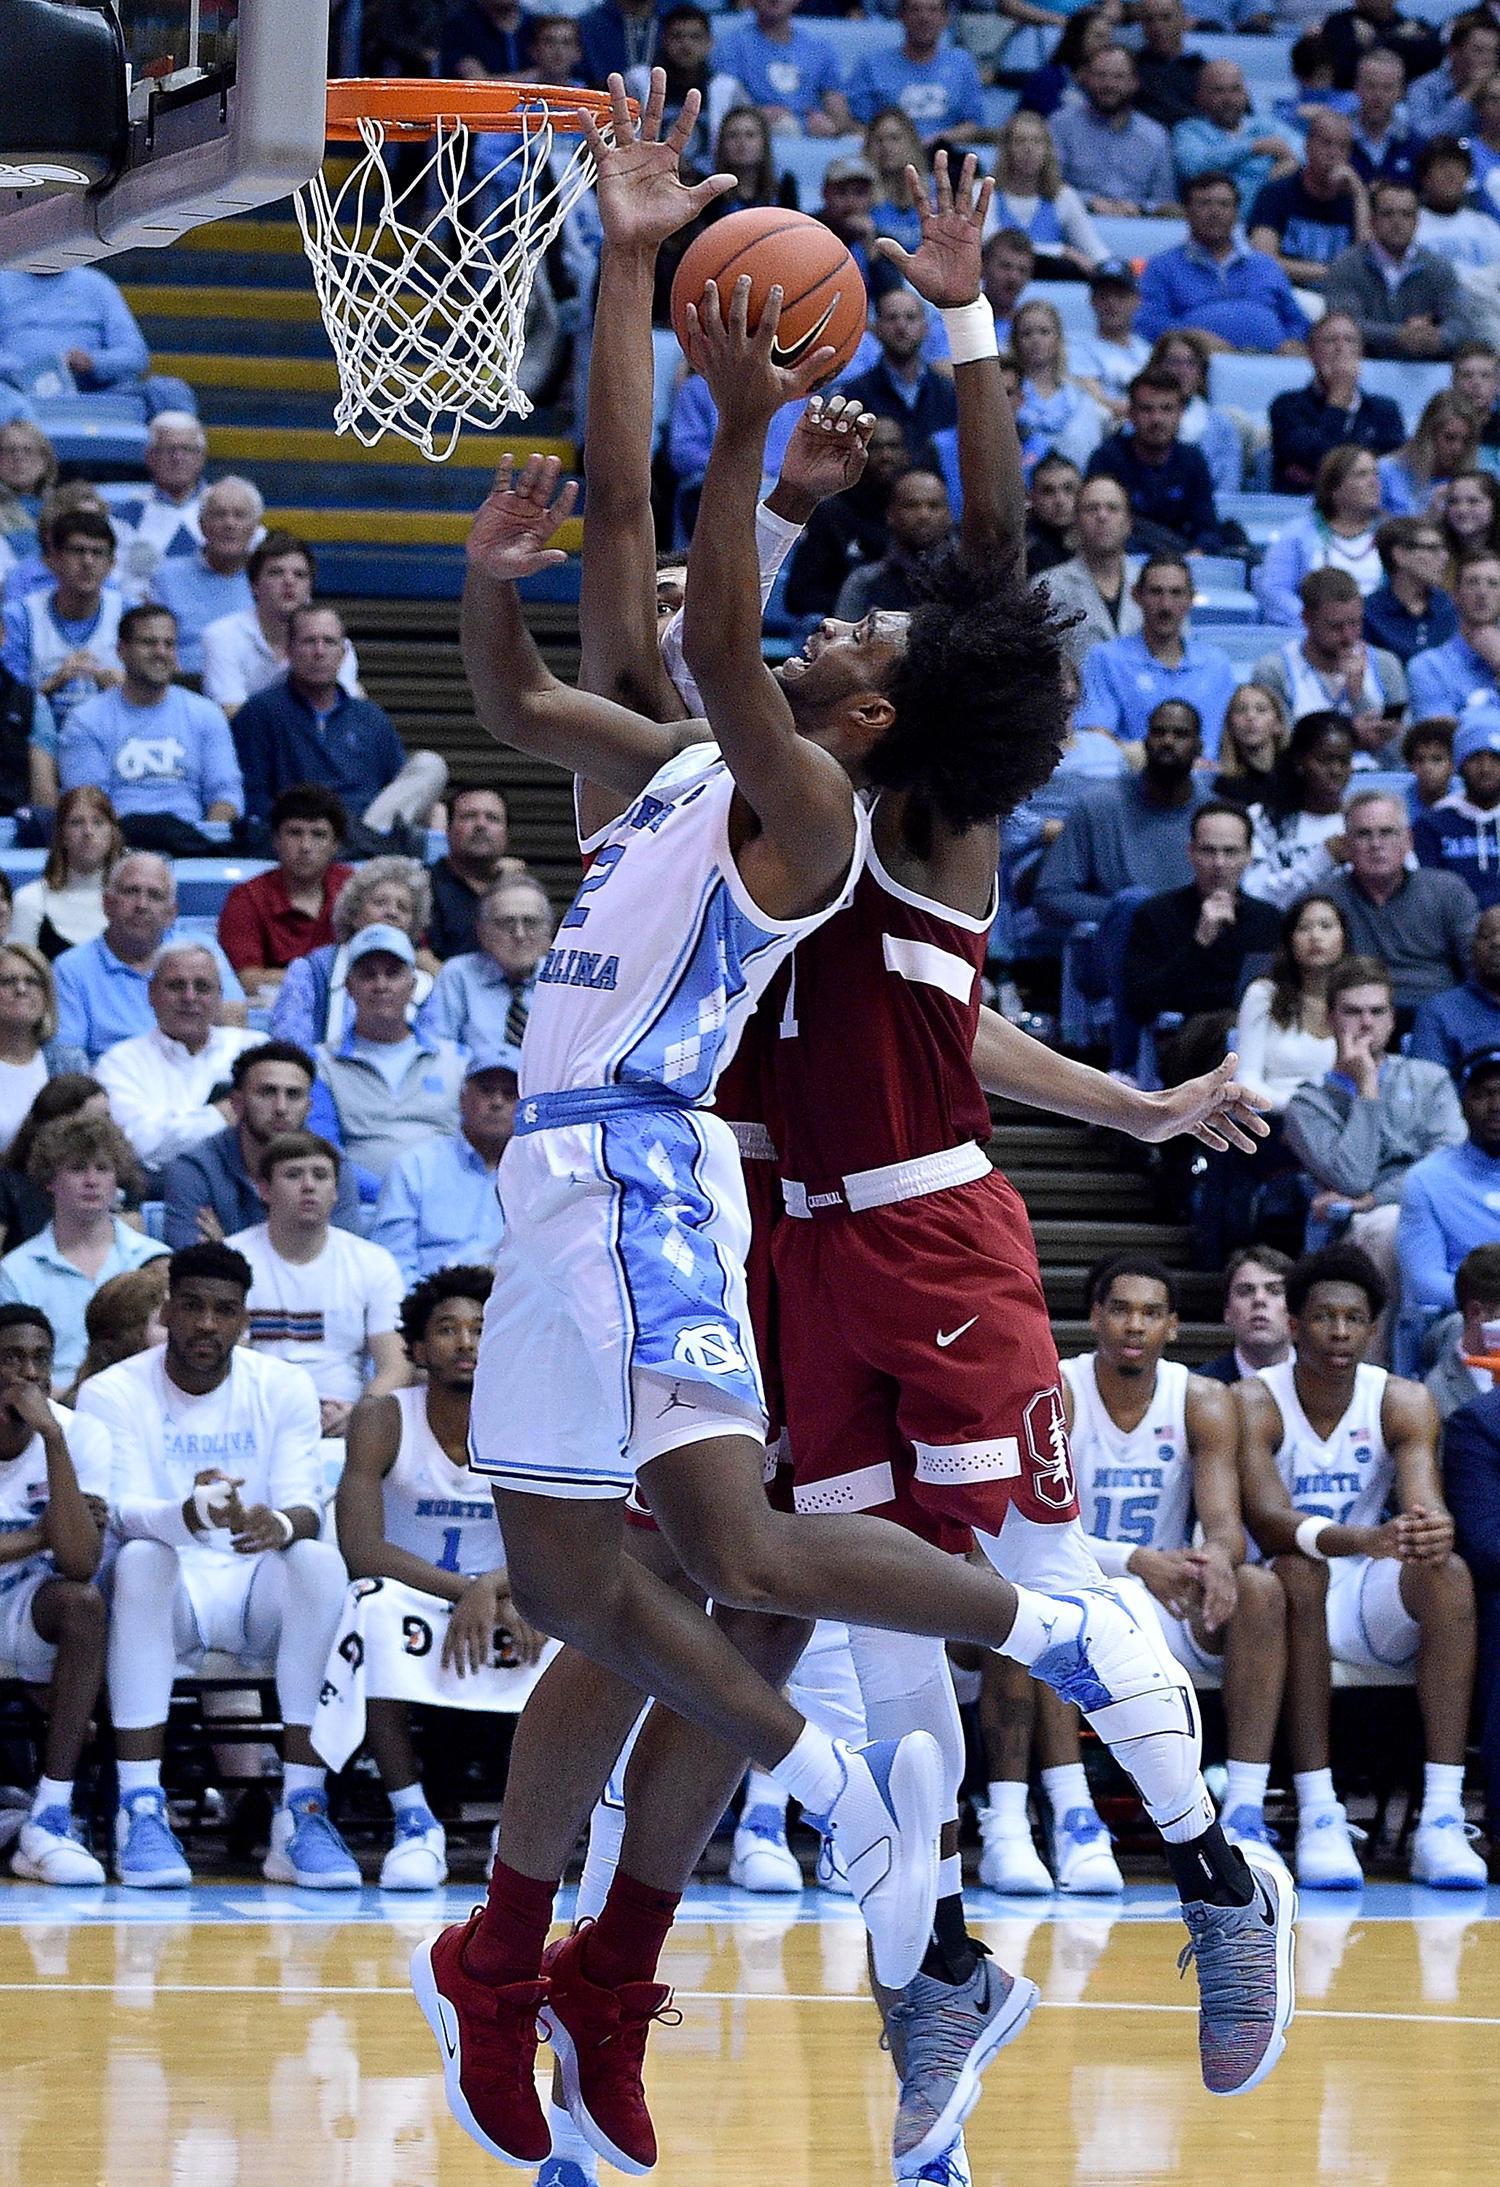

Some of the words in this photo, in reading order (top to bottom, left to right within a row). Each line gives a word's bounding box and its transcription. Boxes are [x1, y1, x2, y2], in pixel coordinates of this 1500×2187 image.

[562, 842, 626, 928] 2
[163, 1430, 256, 1454] CAROLINA
[1092, 1467, 1163, 1488] NORTH
[1292, 1472, 1361, 1495] NORTH
[1088, 1496, 1159, 1545] 15
[436, 1527, 461, 1573] 1
